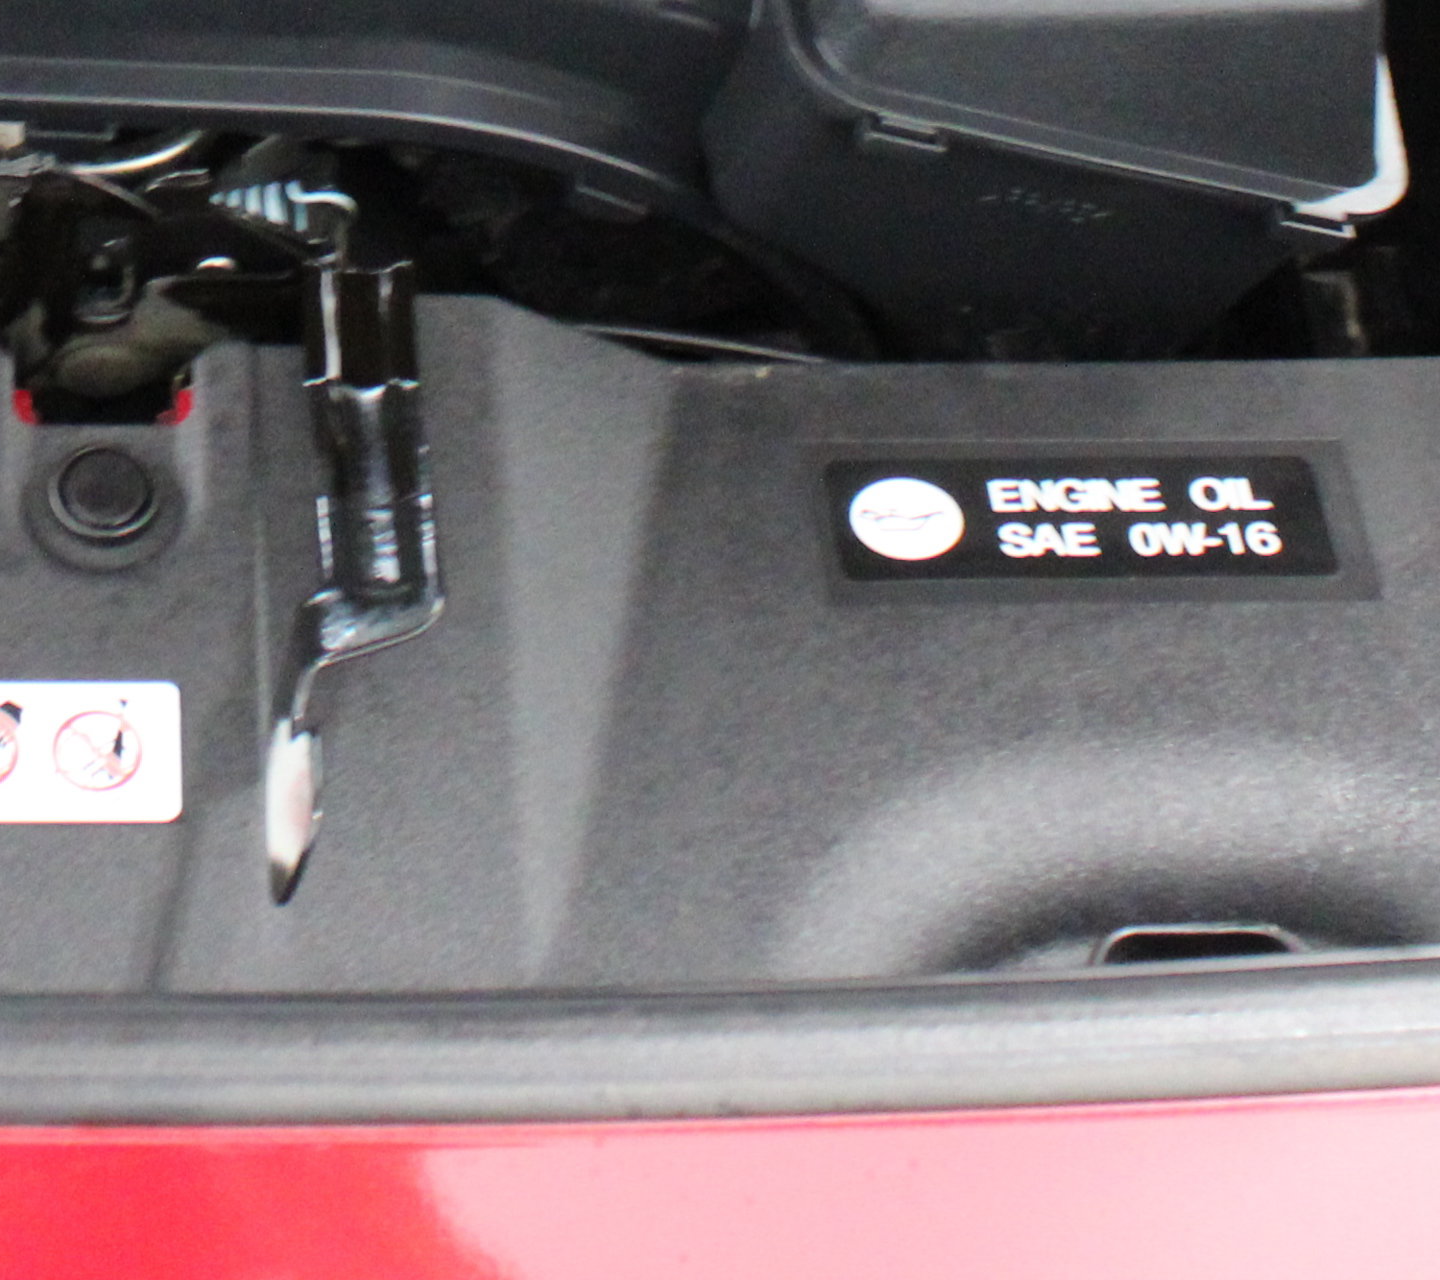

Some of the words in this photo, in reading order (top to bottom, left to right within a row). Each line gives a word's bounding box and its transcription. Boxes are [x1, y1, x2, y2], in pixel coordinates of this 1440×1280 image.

[987, 478, 1165, 512] ENGINE
[1188, 477, 1273, 511] OIL
[998, 522, 1101, 557] SAE
[1128, 521, 1282, 556] 0W-16
